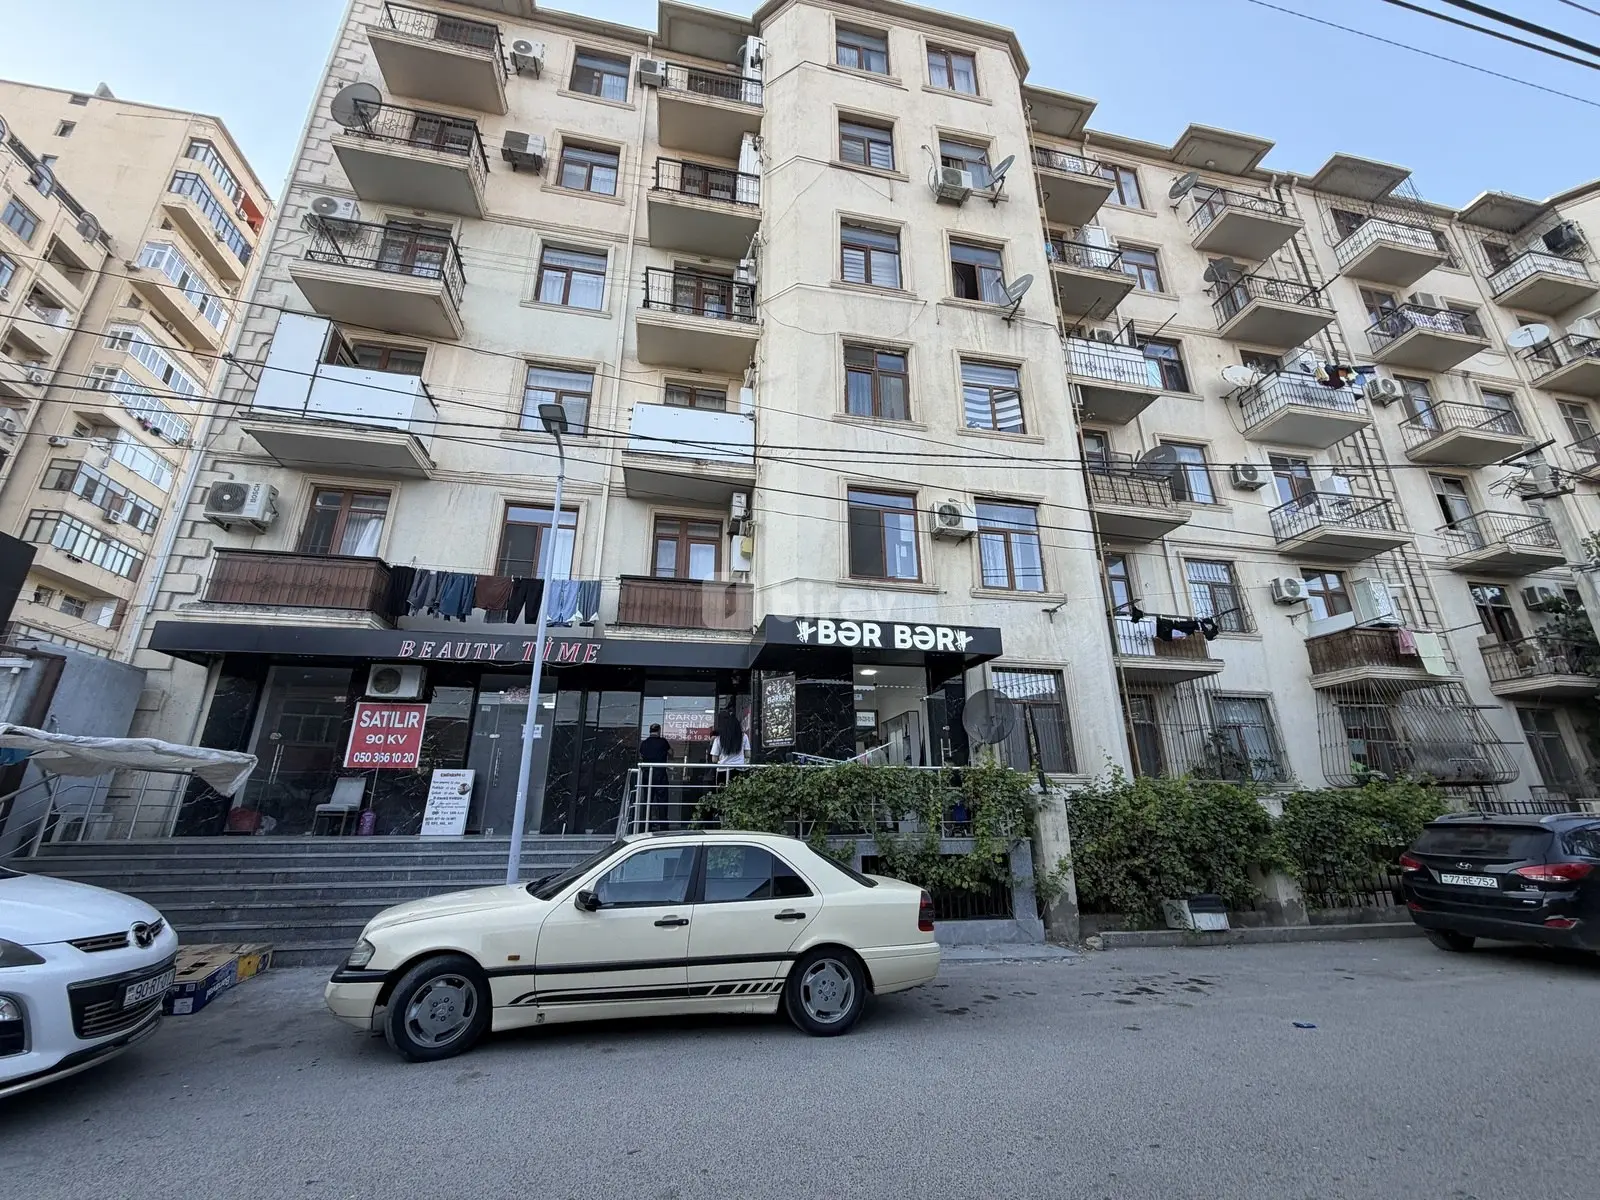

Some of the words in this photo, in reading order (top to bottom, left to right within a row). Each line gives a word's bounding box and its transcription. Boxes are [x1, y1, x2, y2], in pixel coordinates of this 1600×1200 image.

[249, 483, 261, 504] BOSCH
[817, 619, 883, 648] BƏR
[894, 624, 956, 651] BƏR
[397, 639, 503, 661] BEAUTY
[359, 710, 420, 728] SATILIR
[365, 734, 385, 745] 90
[387, 734, 408, 745] KV
[353, 751, 372, 763] 050
[372, 752, 390, 763] 366
[391, 752, 402, 763] 10
[402, 753, 415, 763] 20
